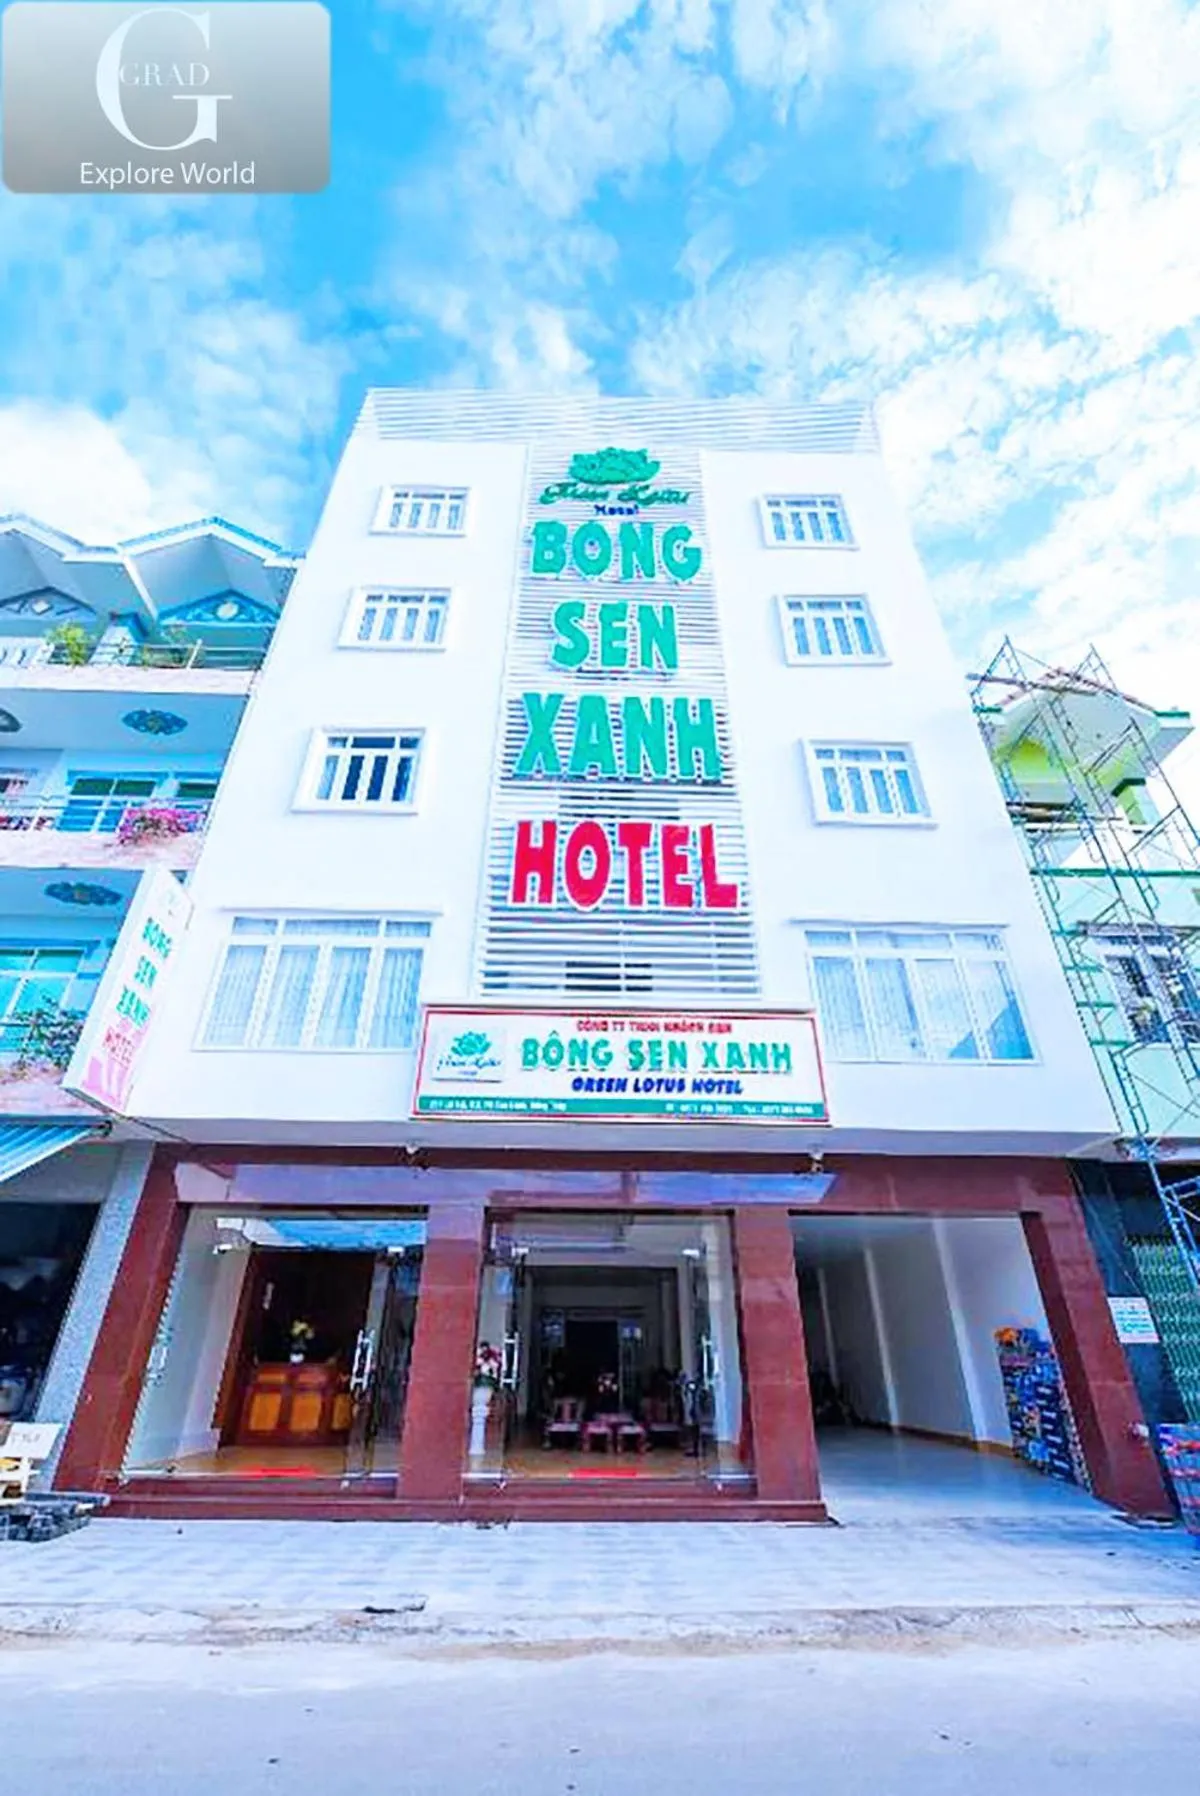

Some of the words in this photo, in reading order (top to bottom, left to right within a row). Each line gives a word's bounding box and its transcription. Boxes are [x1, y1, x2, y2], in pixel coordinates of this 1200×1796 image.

[552, 600, 678, 669] SEN
[514, 692, 722, 777] XANH
[511, 820, 738, 908] HOTEL
[521, 1030, 614, 1069] BÔNG
[629, 1039, 687, 1069] SEN
[701, 1041, 793, 1073] XANH
[572, 1076, 627, 1093] GREEN
[633, 1077, 686, 1094] LOTUS
[691, 1079, 743, 1095] HOTEL
